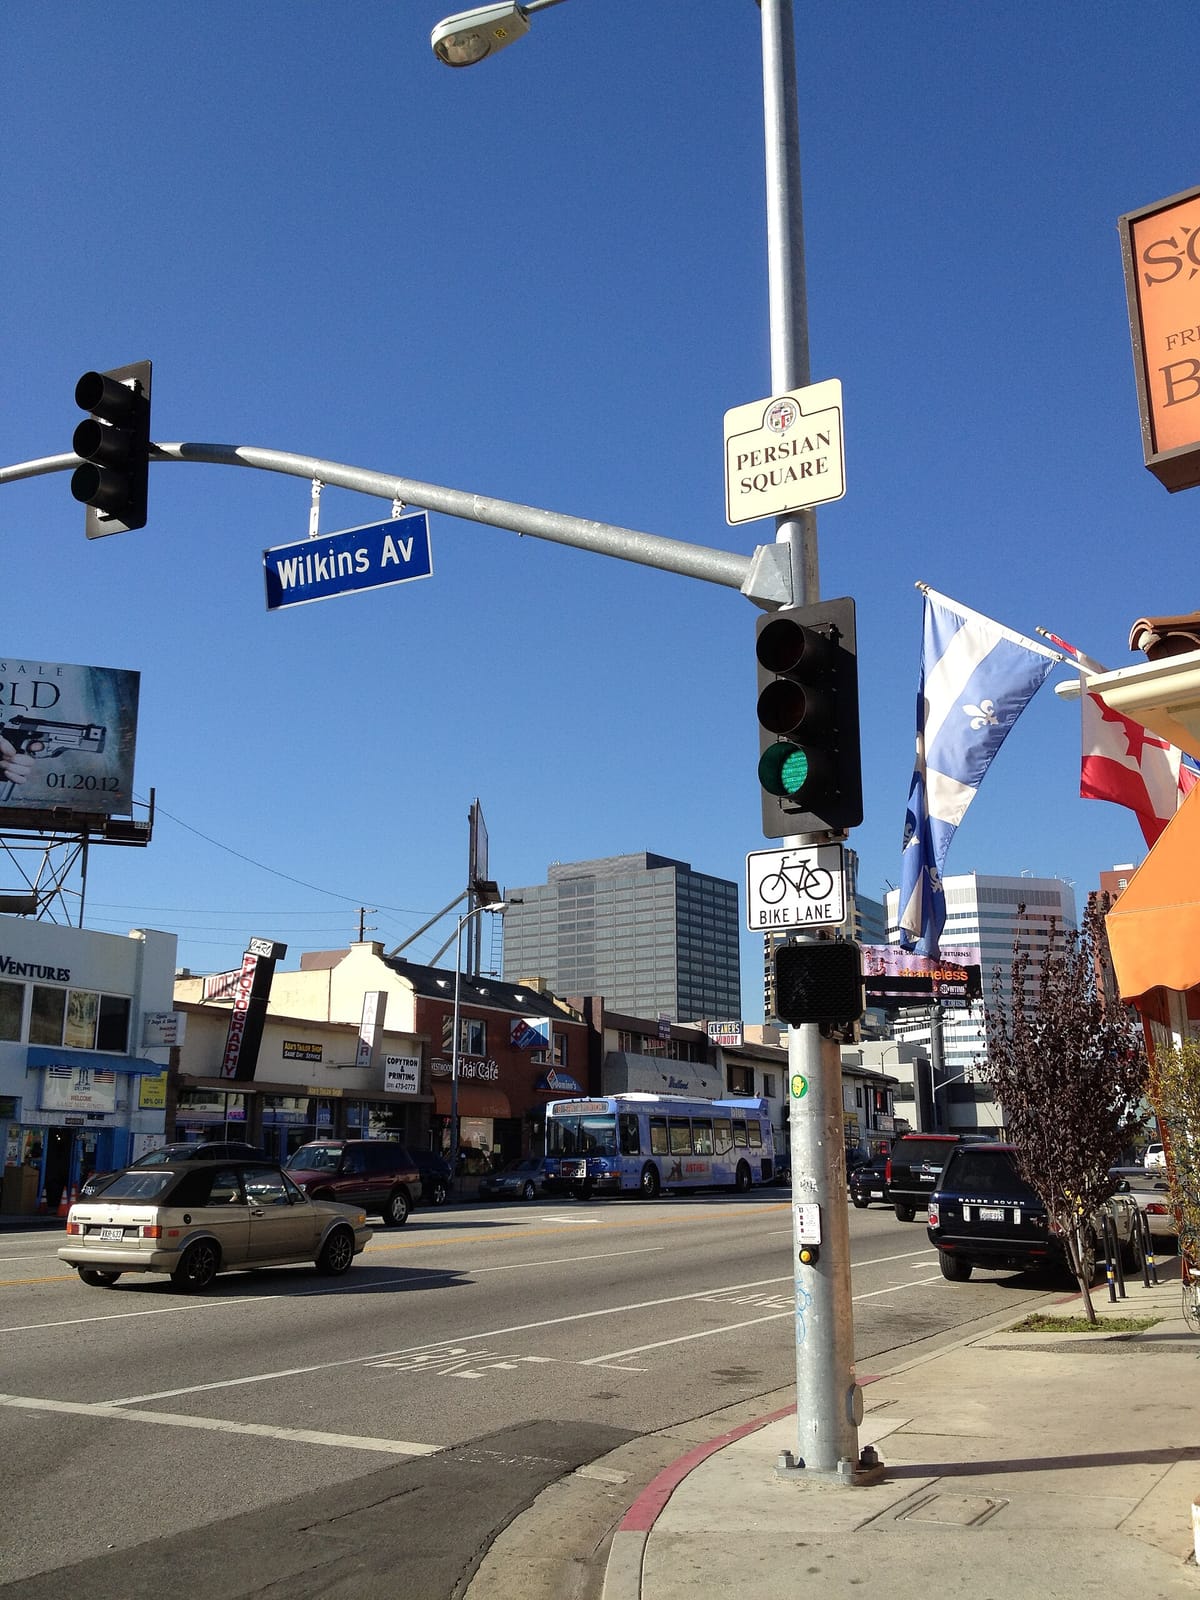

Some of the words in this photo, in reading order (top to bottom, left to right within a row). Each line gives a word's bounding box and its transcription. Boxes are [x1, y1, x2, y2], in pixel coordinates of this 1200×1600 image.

[736, 430, 831, 471] PERSIAN
[740, 456, 829, 494] SQUARE
[276, 548, 370, 590] Wilkins
[380, 534, 414, 568] Av
[46, 772, 120, 793] 01.20.12
[759, 908, 790, 925] BIKE
[796, 903, 832, 922] LANE
[0, 955, 71, 981] VENTURES
[223, 955, 257, 1078] PHOTOGRAPHY
[709, 1023, 740, 1034] CLEANERS
[387, 1057, 418, 1067] COPYTRON
[457, 1056, 476, 1079] Thai
[477, 1058, 499, 1080] Café
[388, 1072, 415, 1082] PRINTING
[958, 1197, 989, 1205] RANGE
